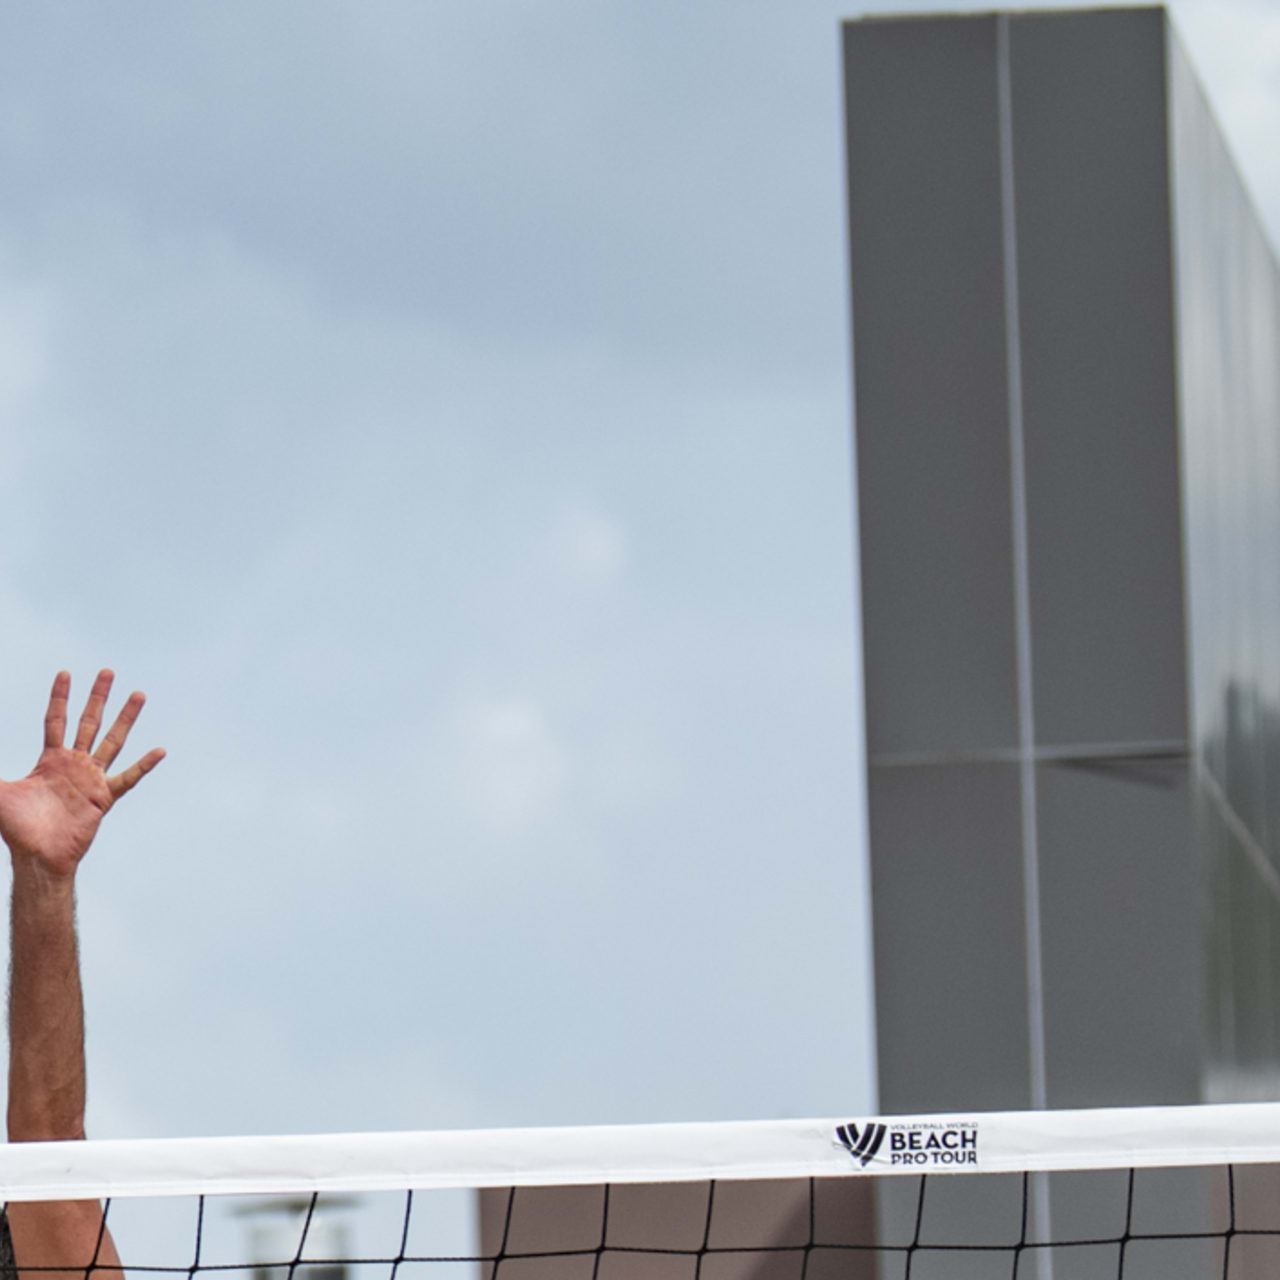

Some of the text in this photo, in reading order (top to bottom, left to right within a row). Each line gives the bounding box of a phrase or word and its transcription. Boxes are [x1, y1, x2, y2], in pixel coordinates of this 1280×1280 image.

[890, 1130, 978, 1150] BEACH
[891, 1150, 978, 1165] PRO TOUR
